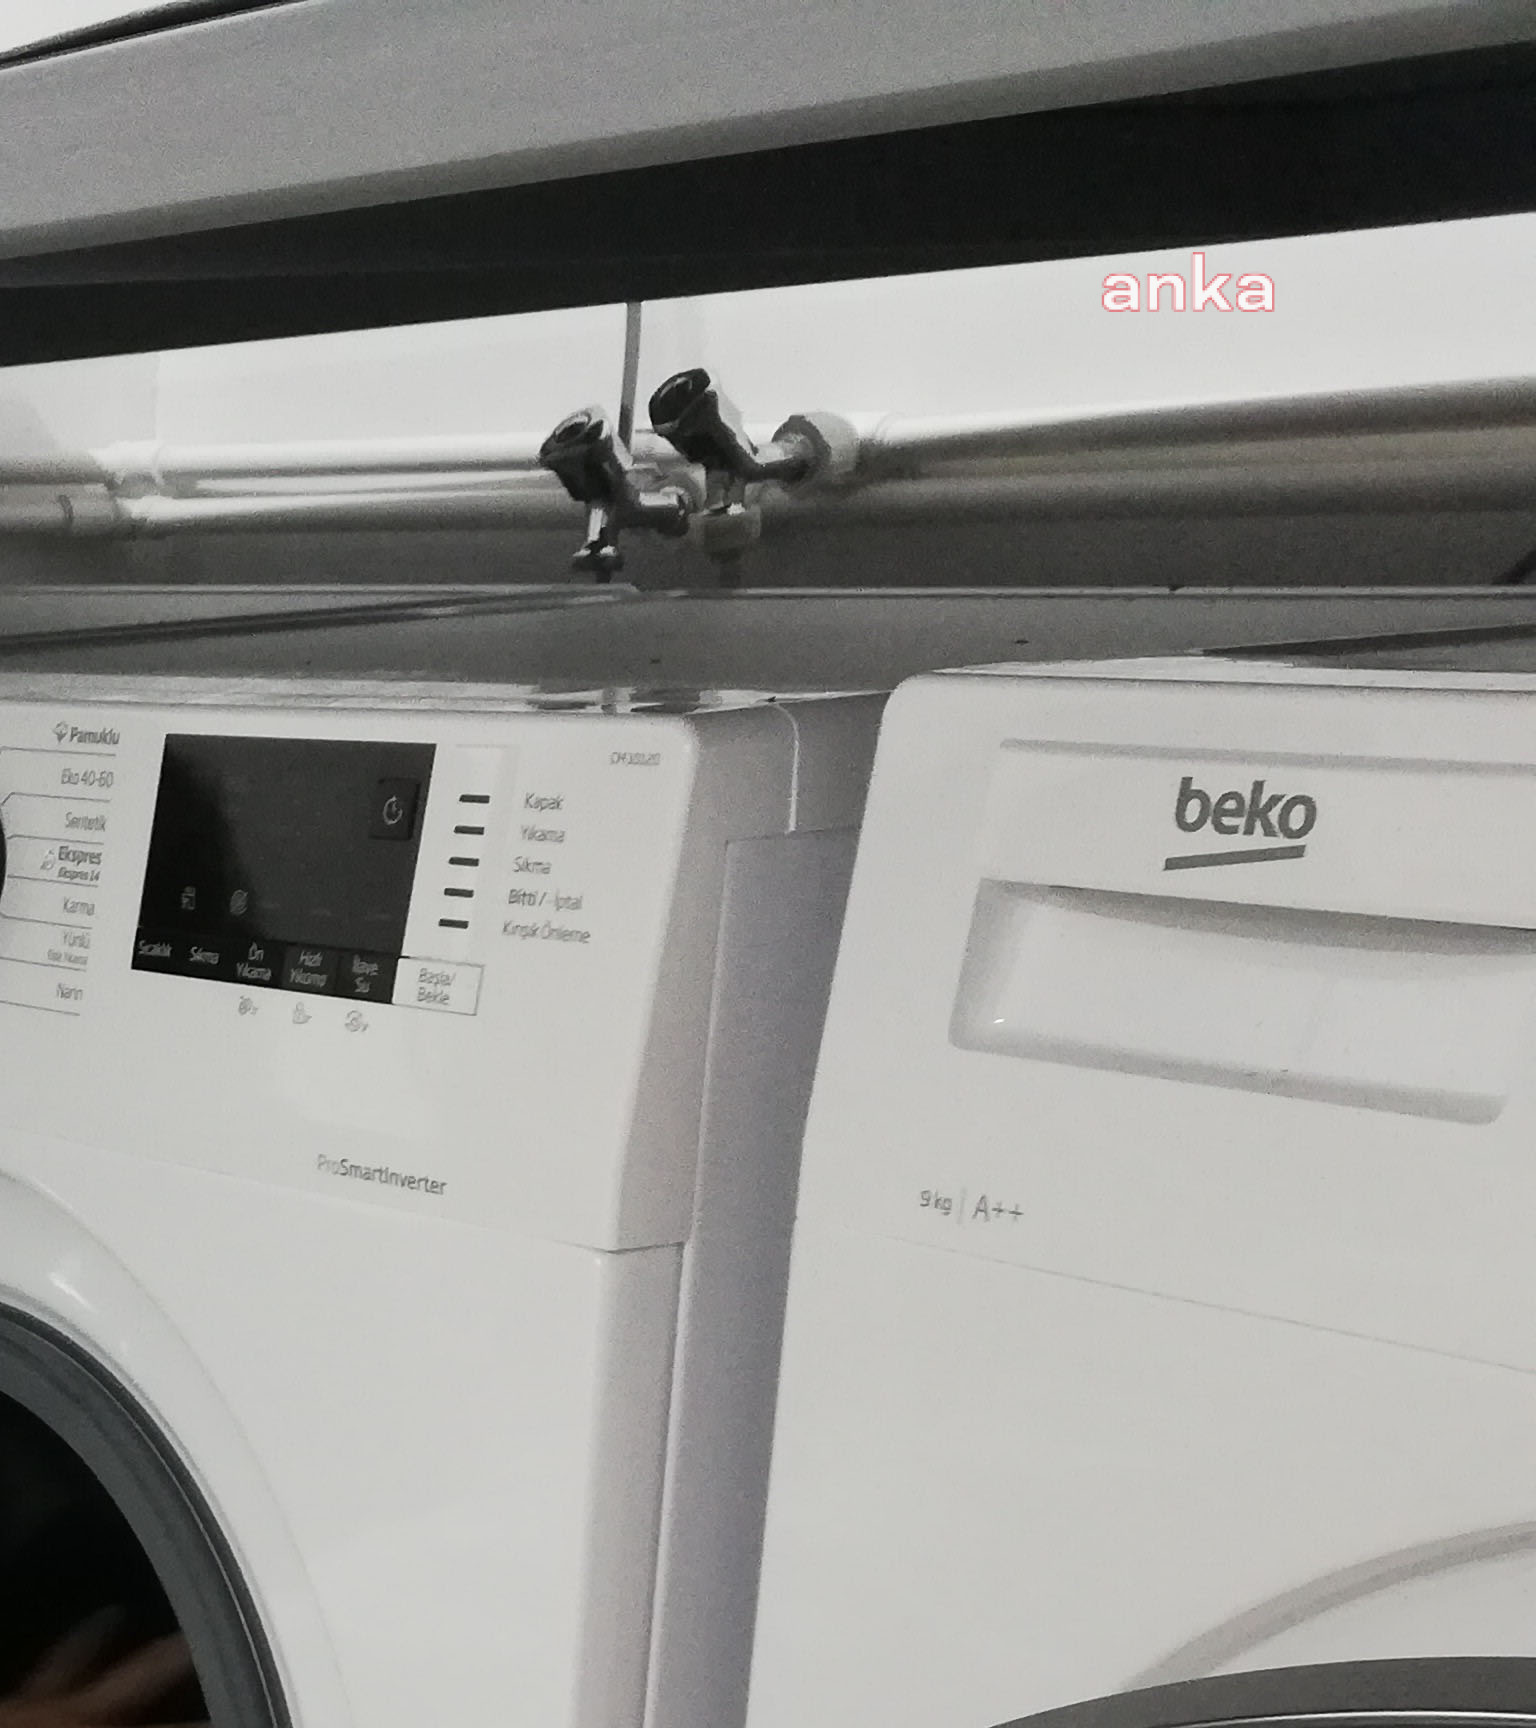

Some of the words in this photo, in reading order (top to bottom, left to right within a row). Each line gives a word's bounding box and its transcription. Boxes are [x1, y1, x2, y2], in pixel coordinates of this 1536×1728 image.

[69, 726, 121, 746] Pamuklu
[1174, 776, 1318, 840] beko
[971, 1195, 1025, 1222] A++
